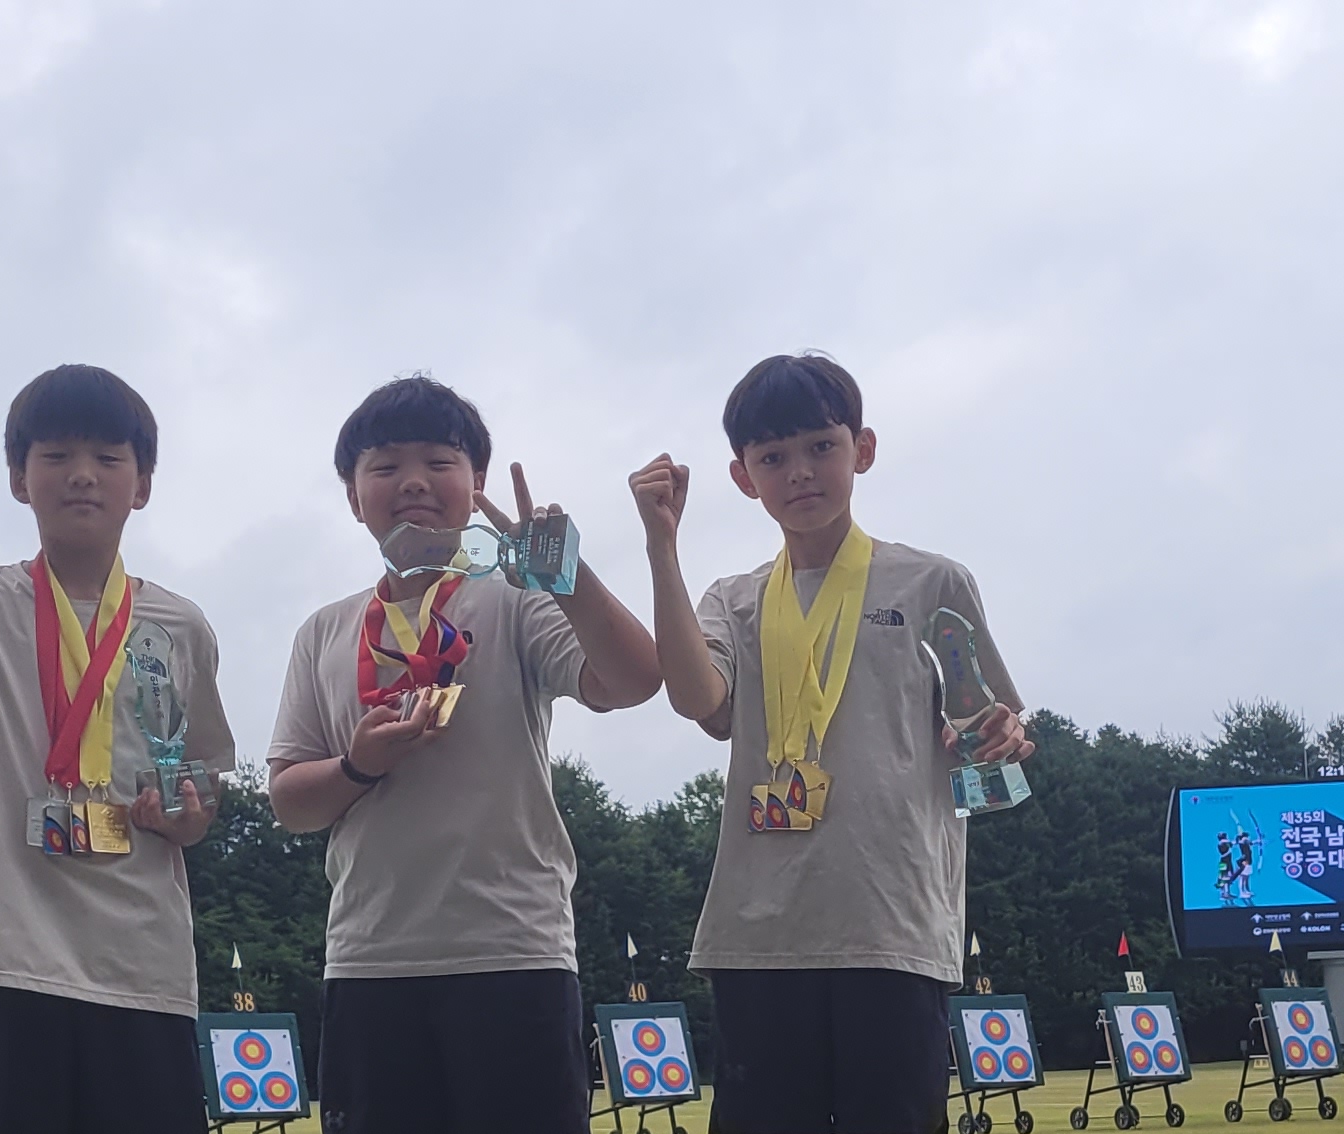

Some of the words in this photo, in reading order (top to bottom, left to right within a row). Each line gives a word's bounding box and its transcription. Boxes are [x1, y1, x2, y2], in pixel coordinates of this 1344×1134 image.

[1281, 809, 1325, 825] 제35회
[1281, 825, 1321, 848] 전국
[1307, 925, 1331, 933] KOLON
[975, 976, 992, 994] 42
[1129, 975, 1145, 993] 43
[1282, 971, 1299, 988] 44
[628, 982, 647, 1002] 40
[233, 991, 255, 1012] 38
